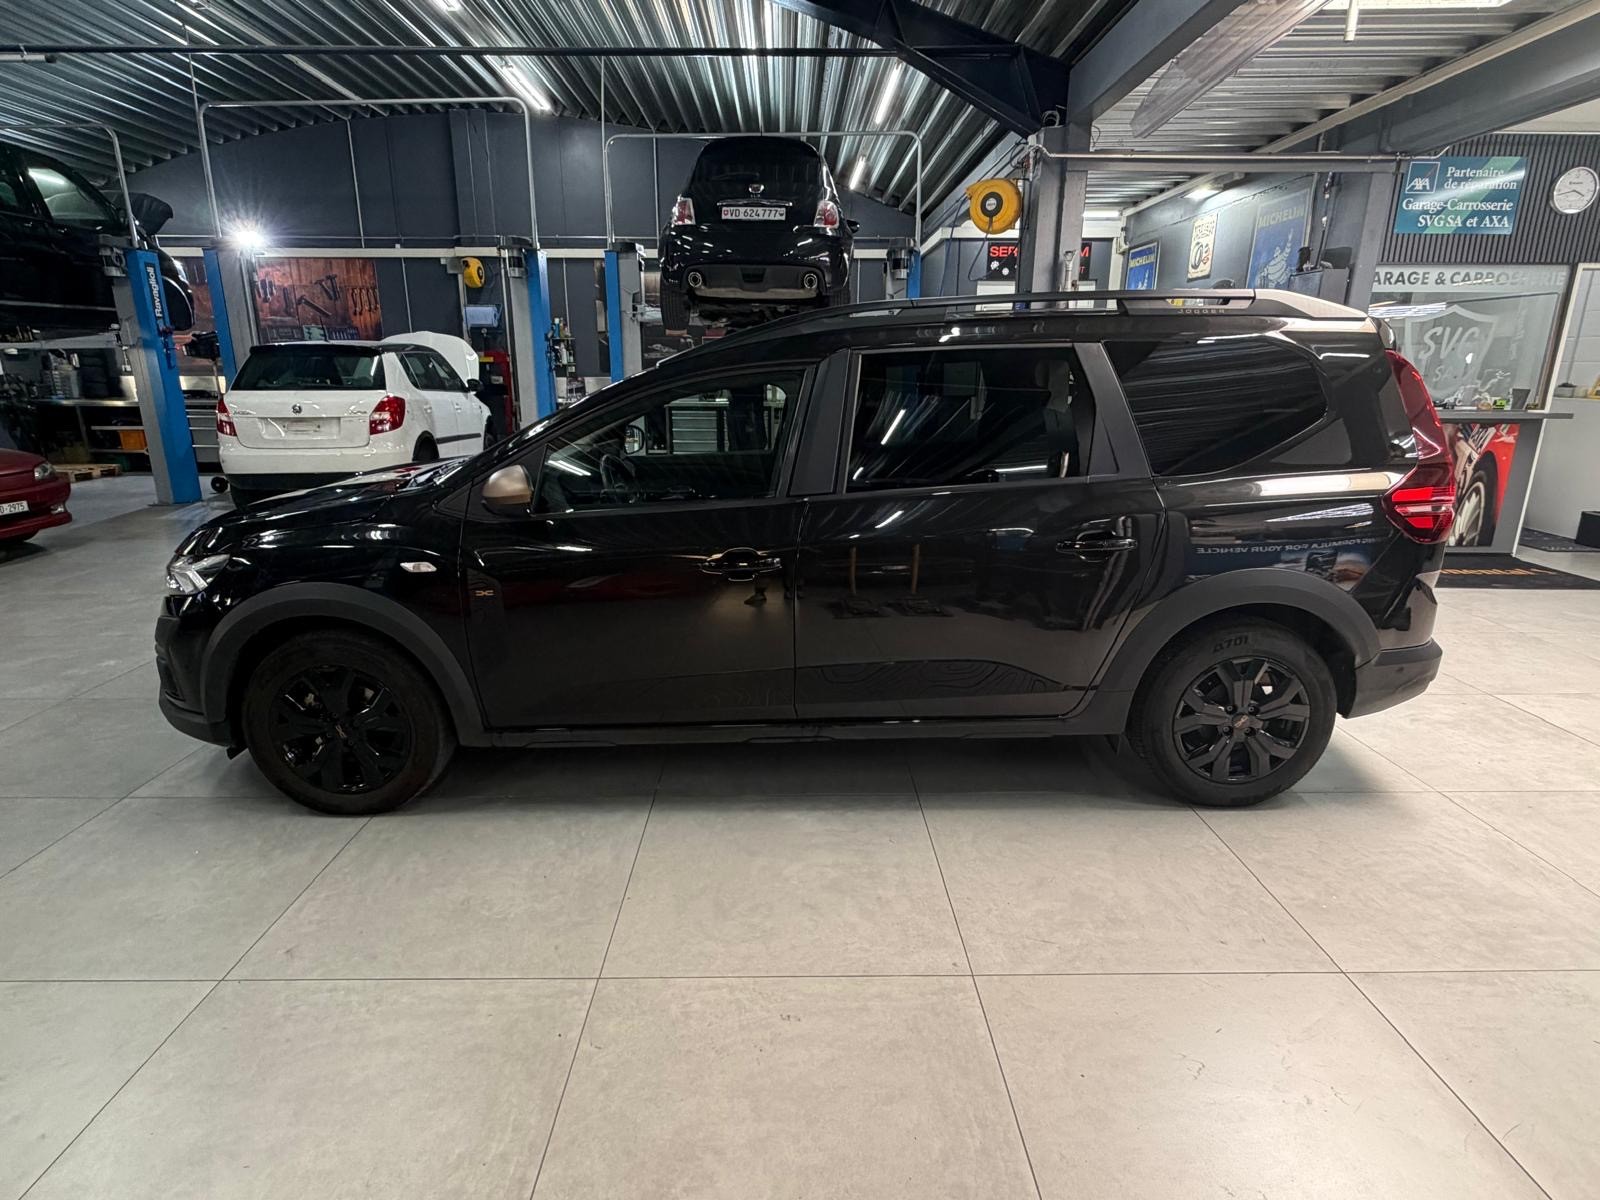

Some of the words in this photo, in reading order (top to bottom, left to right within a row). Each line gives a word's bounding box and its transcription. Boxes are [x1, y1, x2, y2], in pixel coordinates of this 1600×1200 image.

[1446, 166, 1504, 178] Partenaire
[1407, 177, 1430, 190] AXA
[1444, 178, 1457, 190] de
[1258, 206, 1305, 228] MICHELIN
[1417, 214, 1445, 227] SVG
[1446, 214, 1462, 227] SA
[1466, 217, 1478, 227] et
[1480, 215, 1510, 228] AXA
[1373, 271, 1430, 285] ARAGE
[1435, 271, 1446, 285] &
[146, 266, 163, 317] Ravaglioli
